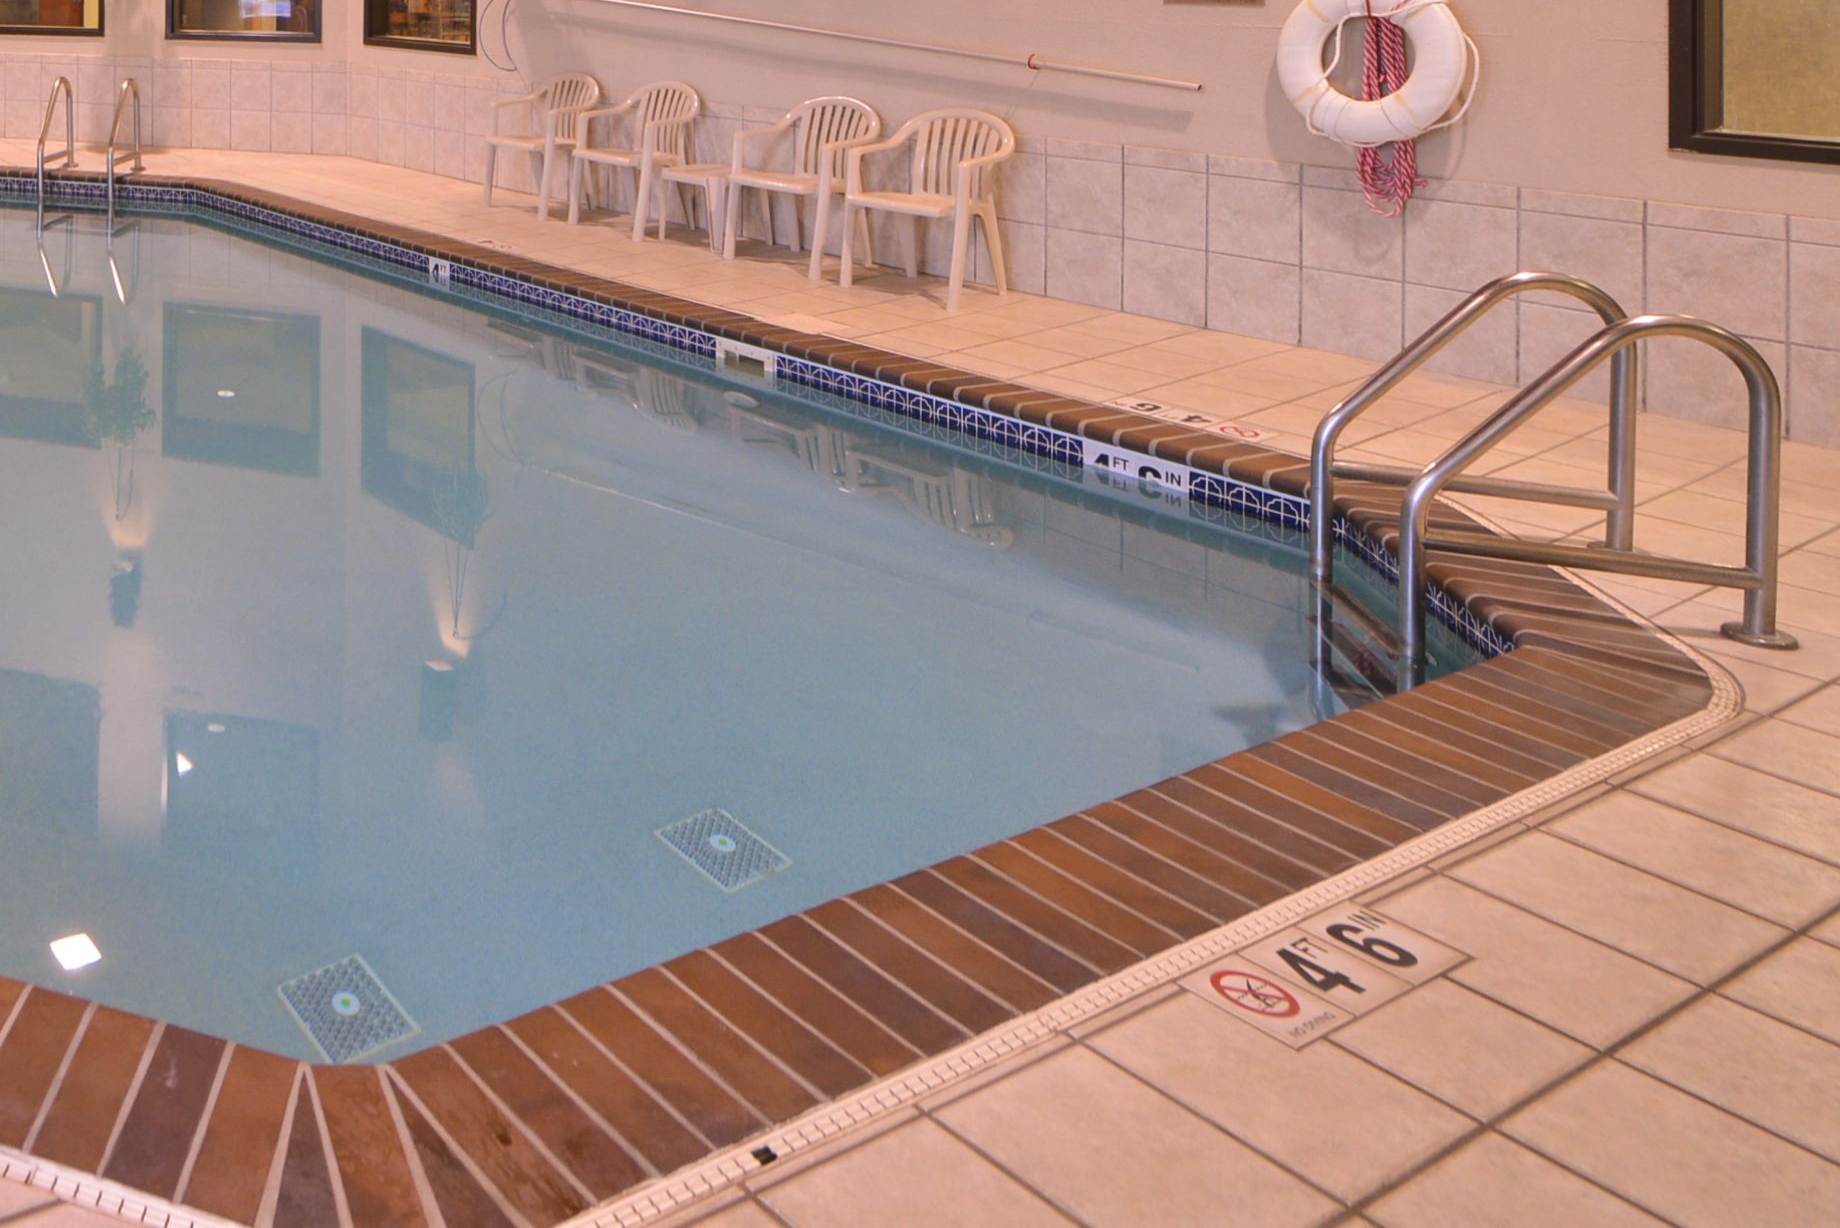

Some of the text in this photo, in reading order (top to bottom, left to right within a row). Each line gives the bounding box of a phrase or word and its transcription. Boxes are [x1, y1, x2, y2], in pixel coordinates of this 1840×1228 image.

[1113, 456, 1129, 470] FT
[1165, 471, 1182, 486] IN
[1275, 910, 1419, 994] 4 FT 6 IN
